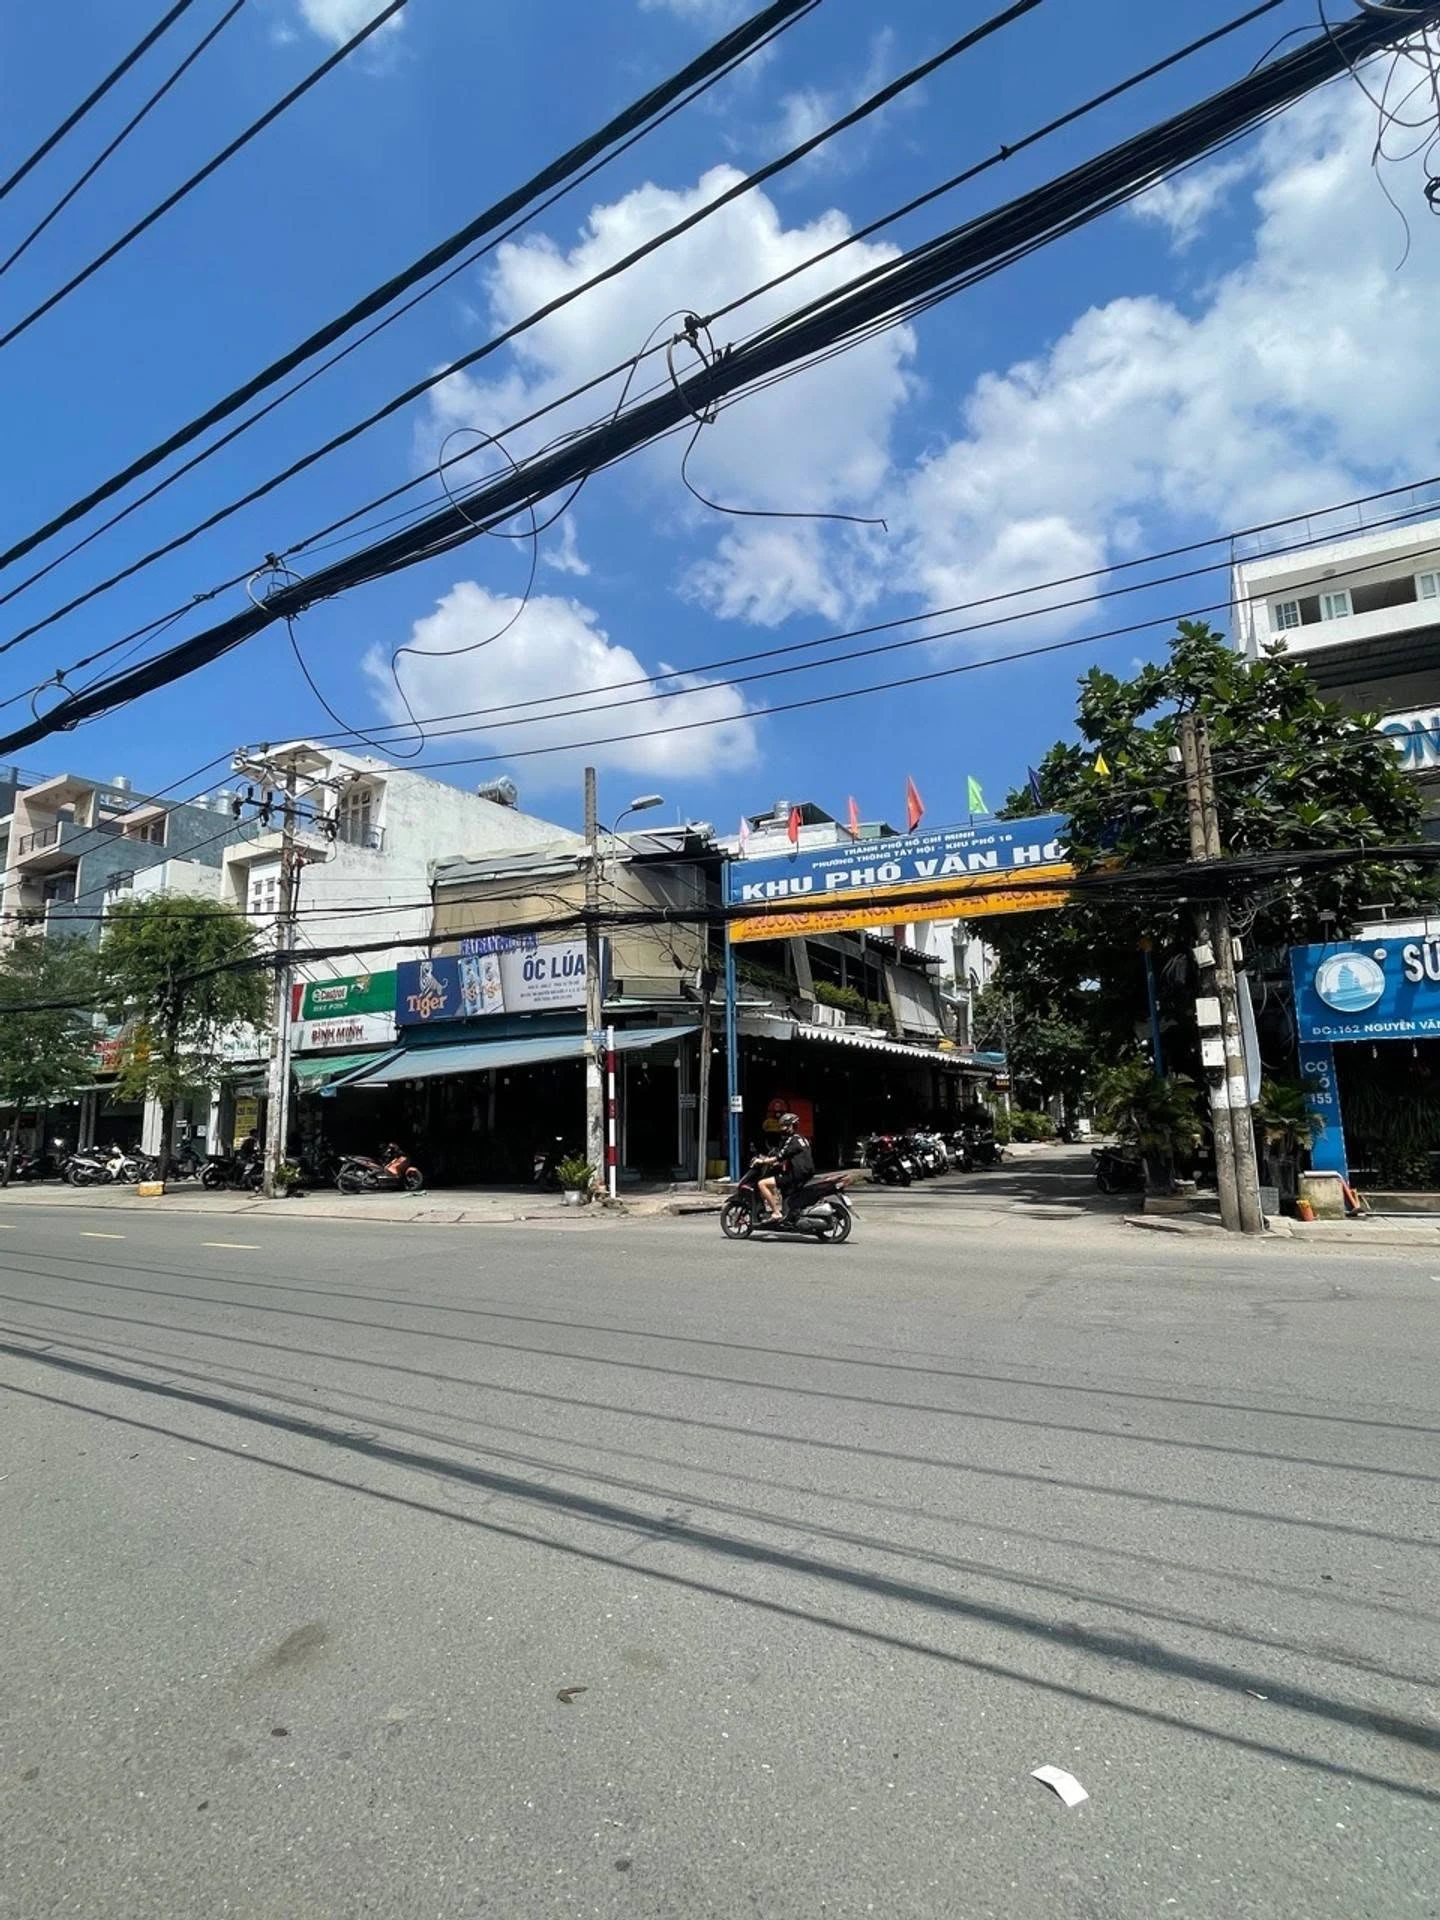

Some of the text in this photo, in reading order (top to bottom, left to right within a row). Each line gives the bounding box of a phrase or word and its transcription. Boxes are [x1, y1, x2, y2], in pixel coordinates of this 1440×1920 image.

[945, 831, 975, 842] MINH
[945, 839, 969, 850] KHU
[742, 876, 813, 900] KHU
[825, 857, 902, 890] PHỐ
[914, 851, 998, 878] VĂN
[522, 949, 586, 982] ỐC LÚA
[406, 992, 448, 1018] Tiger
